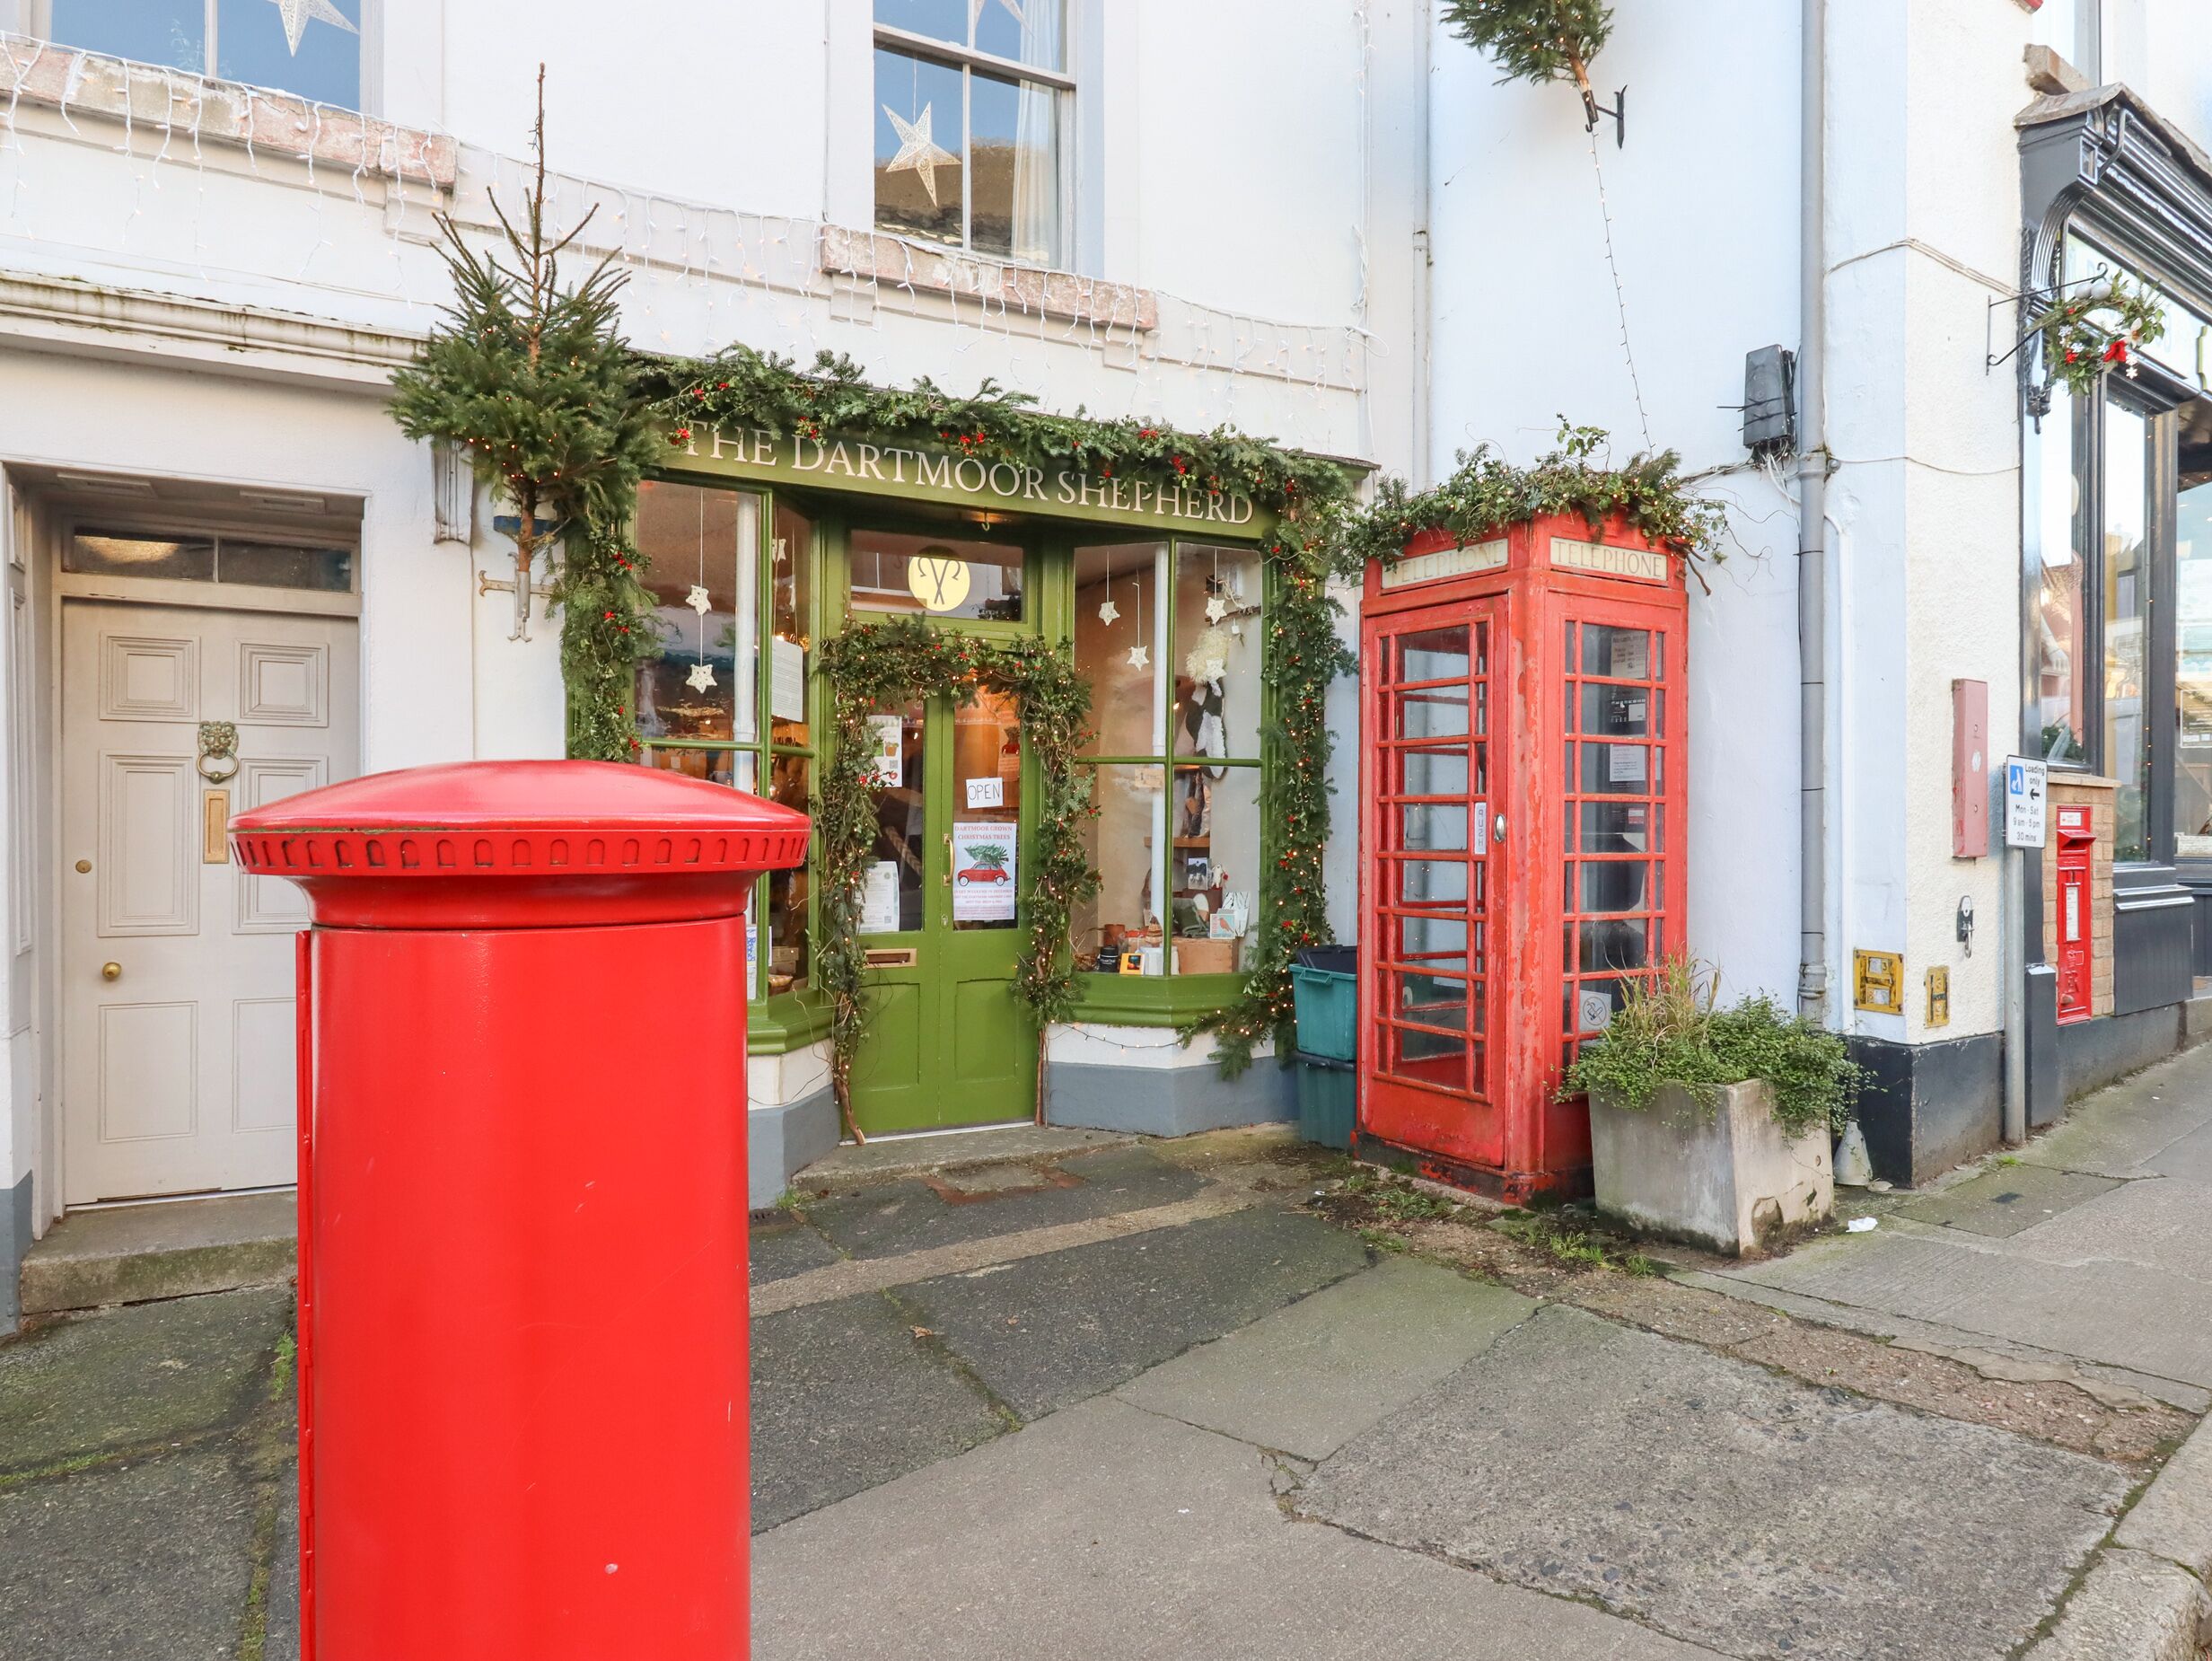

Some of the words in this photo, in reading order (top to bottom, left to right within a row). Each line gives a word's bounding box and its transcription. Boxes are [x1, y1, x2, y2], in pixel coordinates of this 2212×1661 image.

[684, 419, 777, 466] THE
[791, 434, 1049, 500] DARTMOOR
[1058, 470, 1254, 524] SHEPHERD
[1554, 540, 1663, 577] TELEPHONE
[2024, 763, 2045, 776] Loading
[2030, 777, 2041, 787] only
[968, 783, 1000, 800] OPEN
[2015, 804, 2026, 813] Mon
[2030, 806, 2039, 815] Sat
[2016, 831, 2024, 840] 30
[2024, 833, 2037, 841] mins
